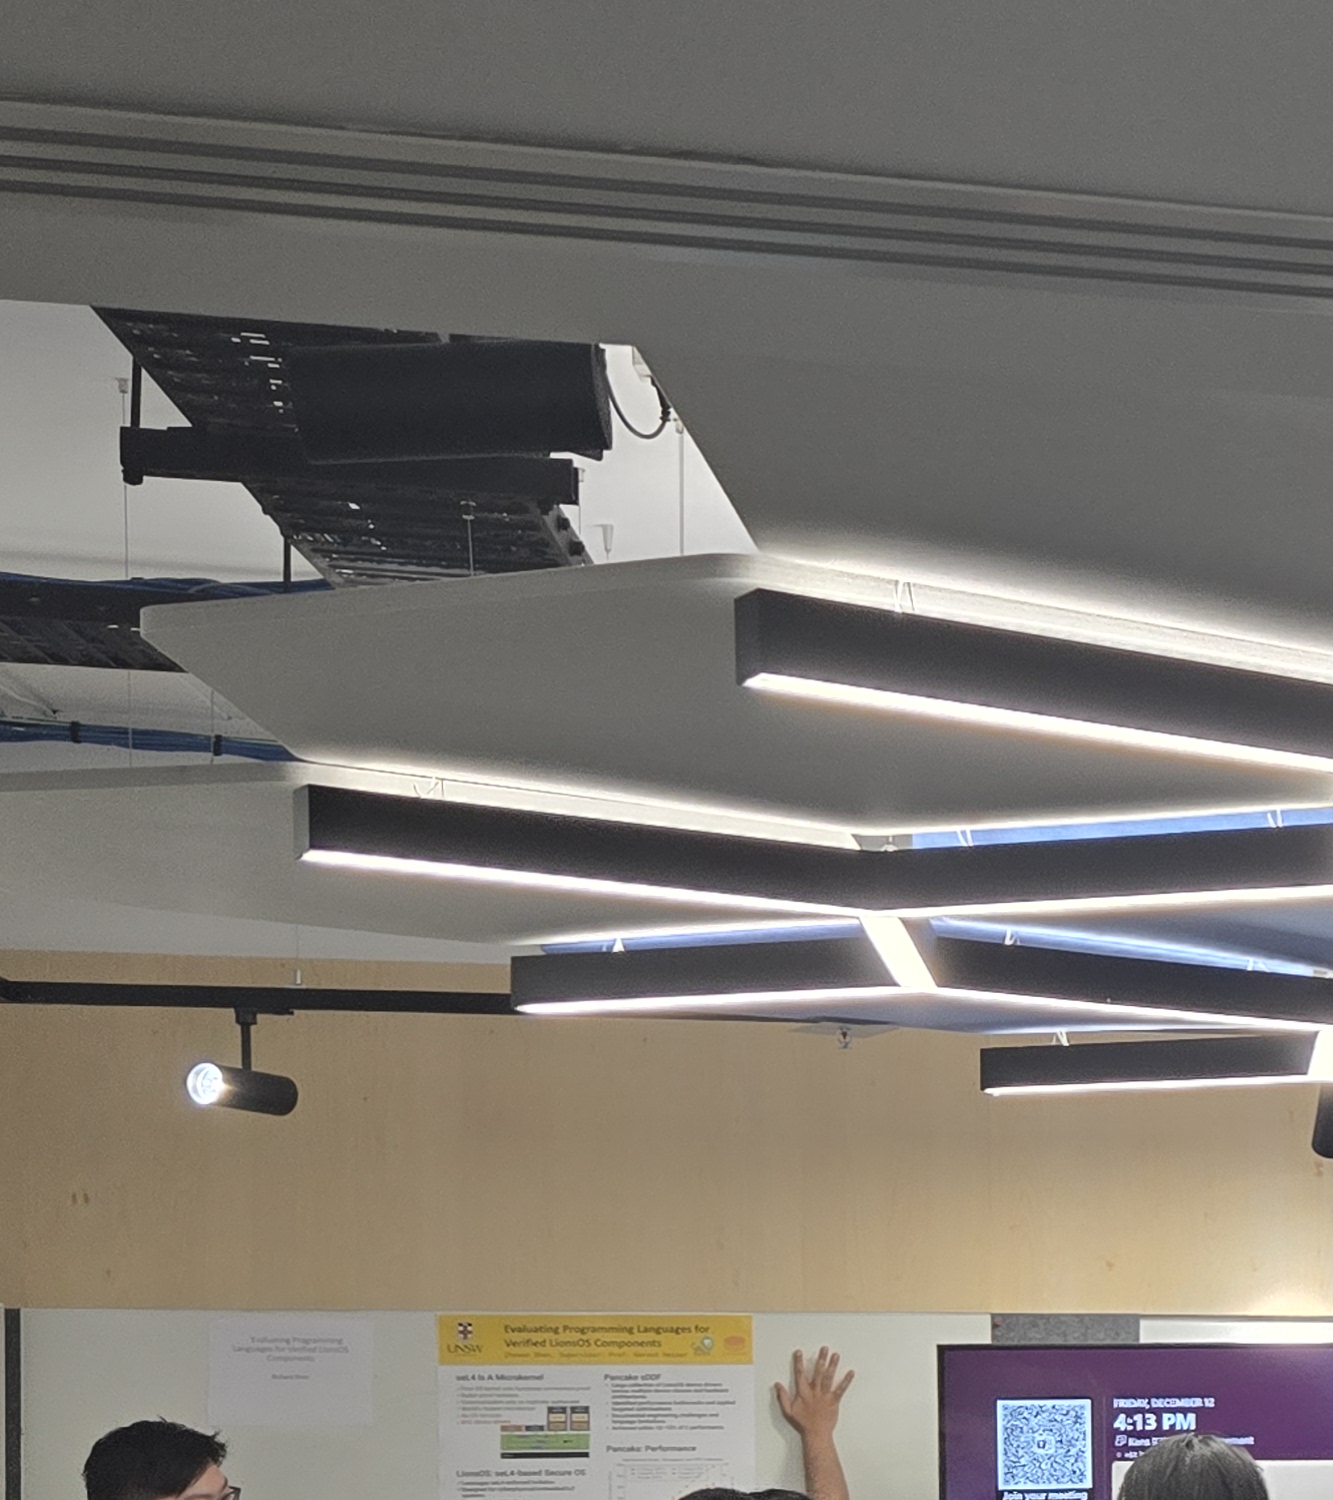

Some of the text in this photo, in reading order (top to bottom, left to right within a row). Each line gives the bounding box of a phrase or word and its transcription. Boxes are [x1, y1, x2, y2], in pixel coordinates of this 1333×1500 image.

[504, 1324, 710, 1335] Evaluating Programming Languages for
[446, 1344, 483, 1353] UNSW
[504, 1338, 662, 1349] Verified LionsOS Components
[1113, 1412, 1197, 1431] 4:13 PM
